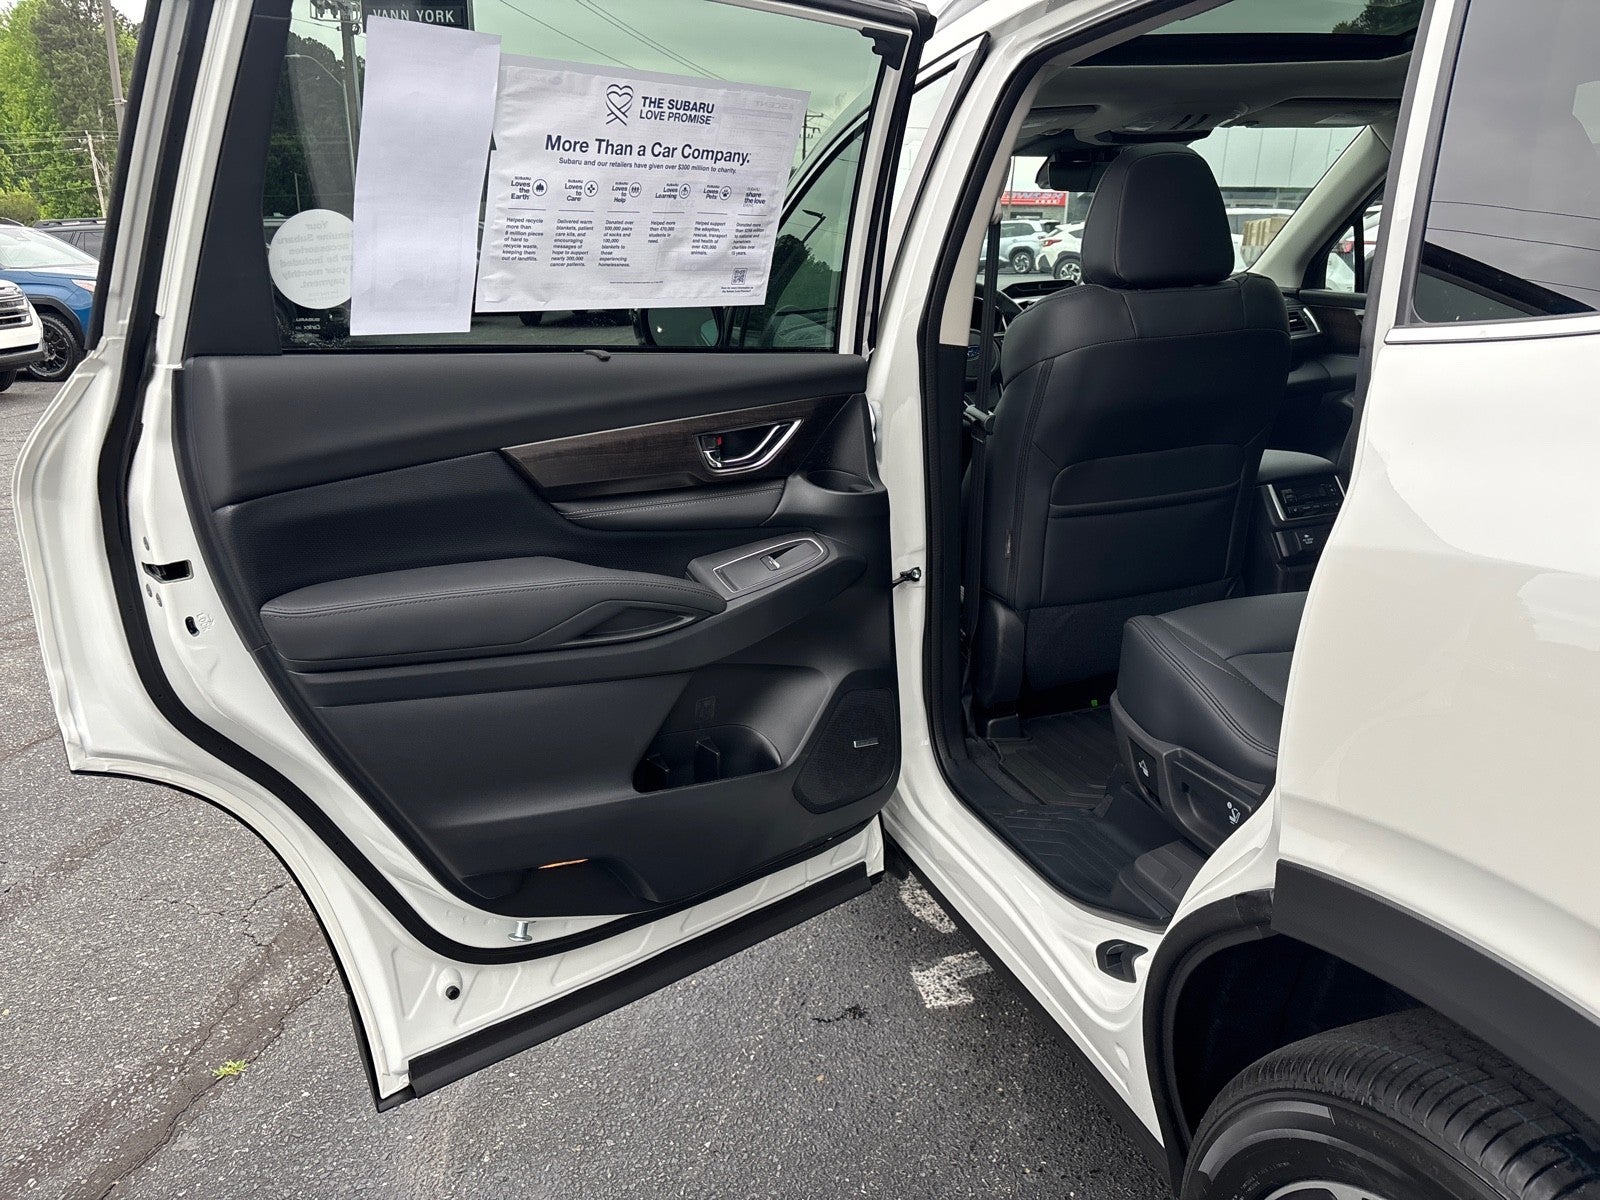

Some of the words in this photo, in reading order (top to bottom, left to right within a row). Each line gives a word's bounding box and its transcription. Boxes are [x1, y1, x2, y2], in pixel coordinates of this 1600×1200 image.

[417, 10, 454, 22] YORK
[642, 96, 664, 109] THE
[668, 99, 714, 114] SUBARU
[640, 110, 665, 121] LOVE
[545, 135, 589, 153] More
[595, 138, 632, 156] Than
[637, 144, 646, 156] a
[651, 142, 677, 158] Car
[559, 158, 582, 166] Subaru
